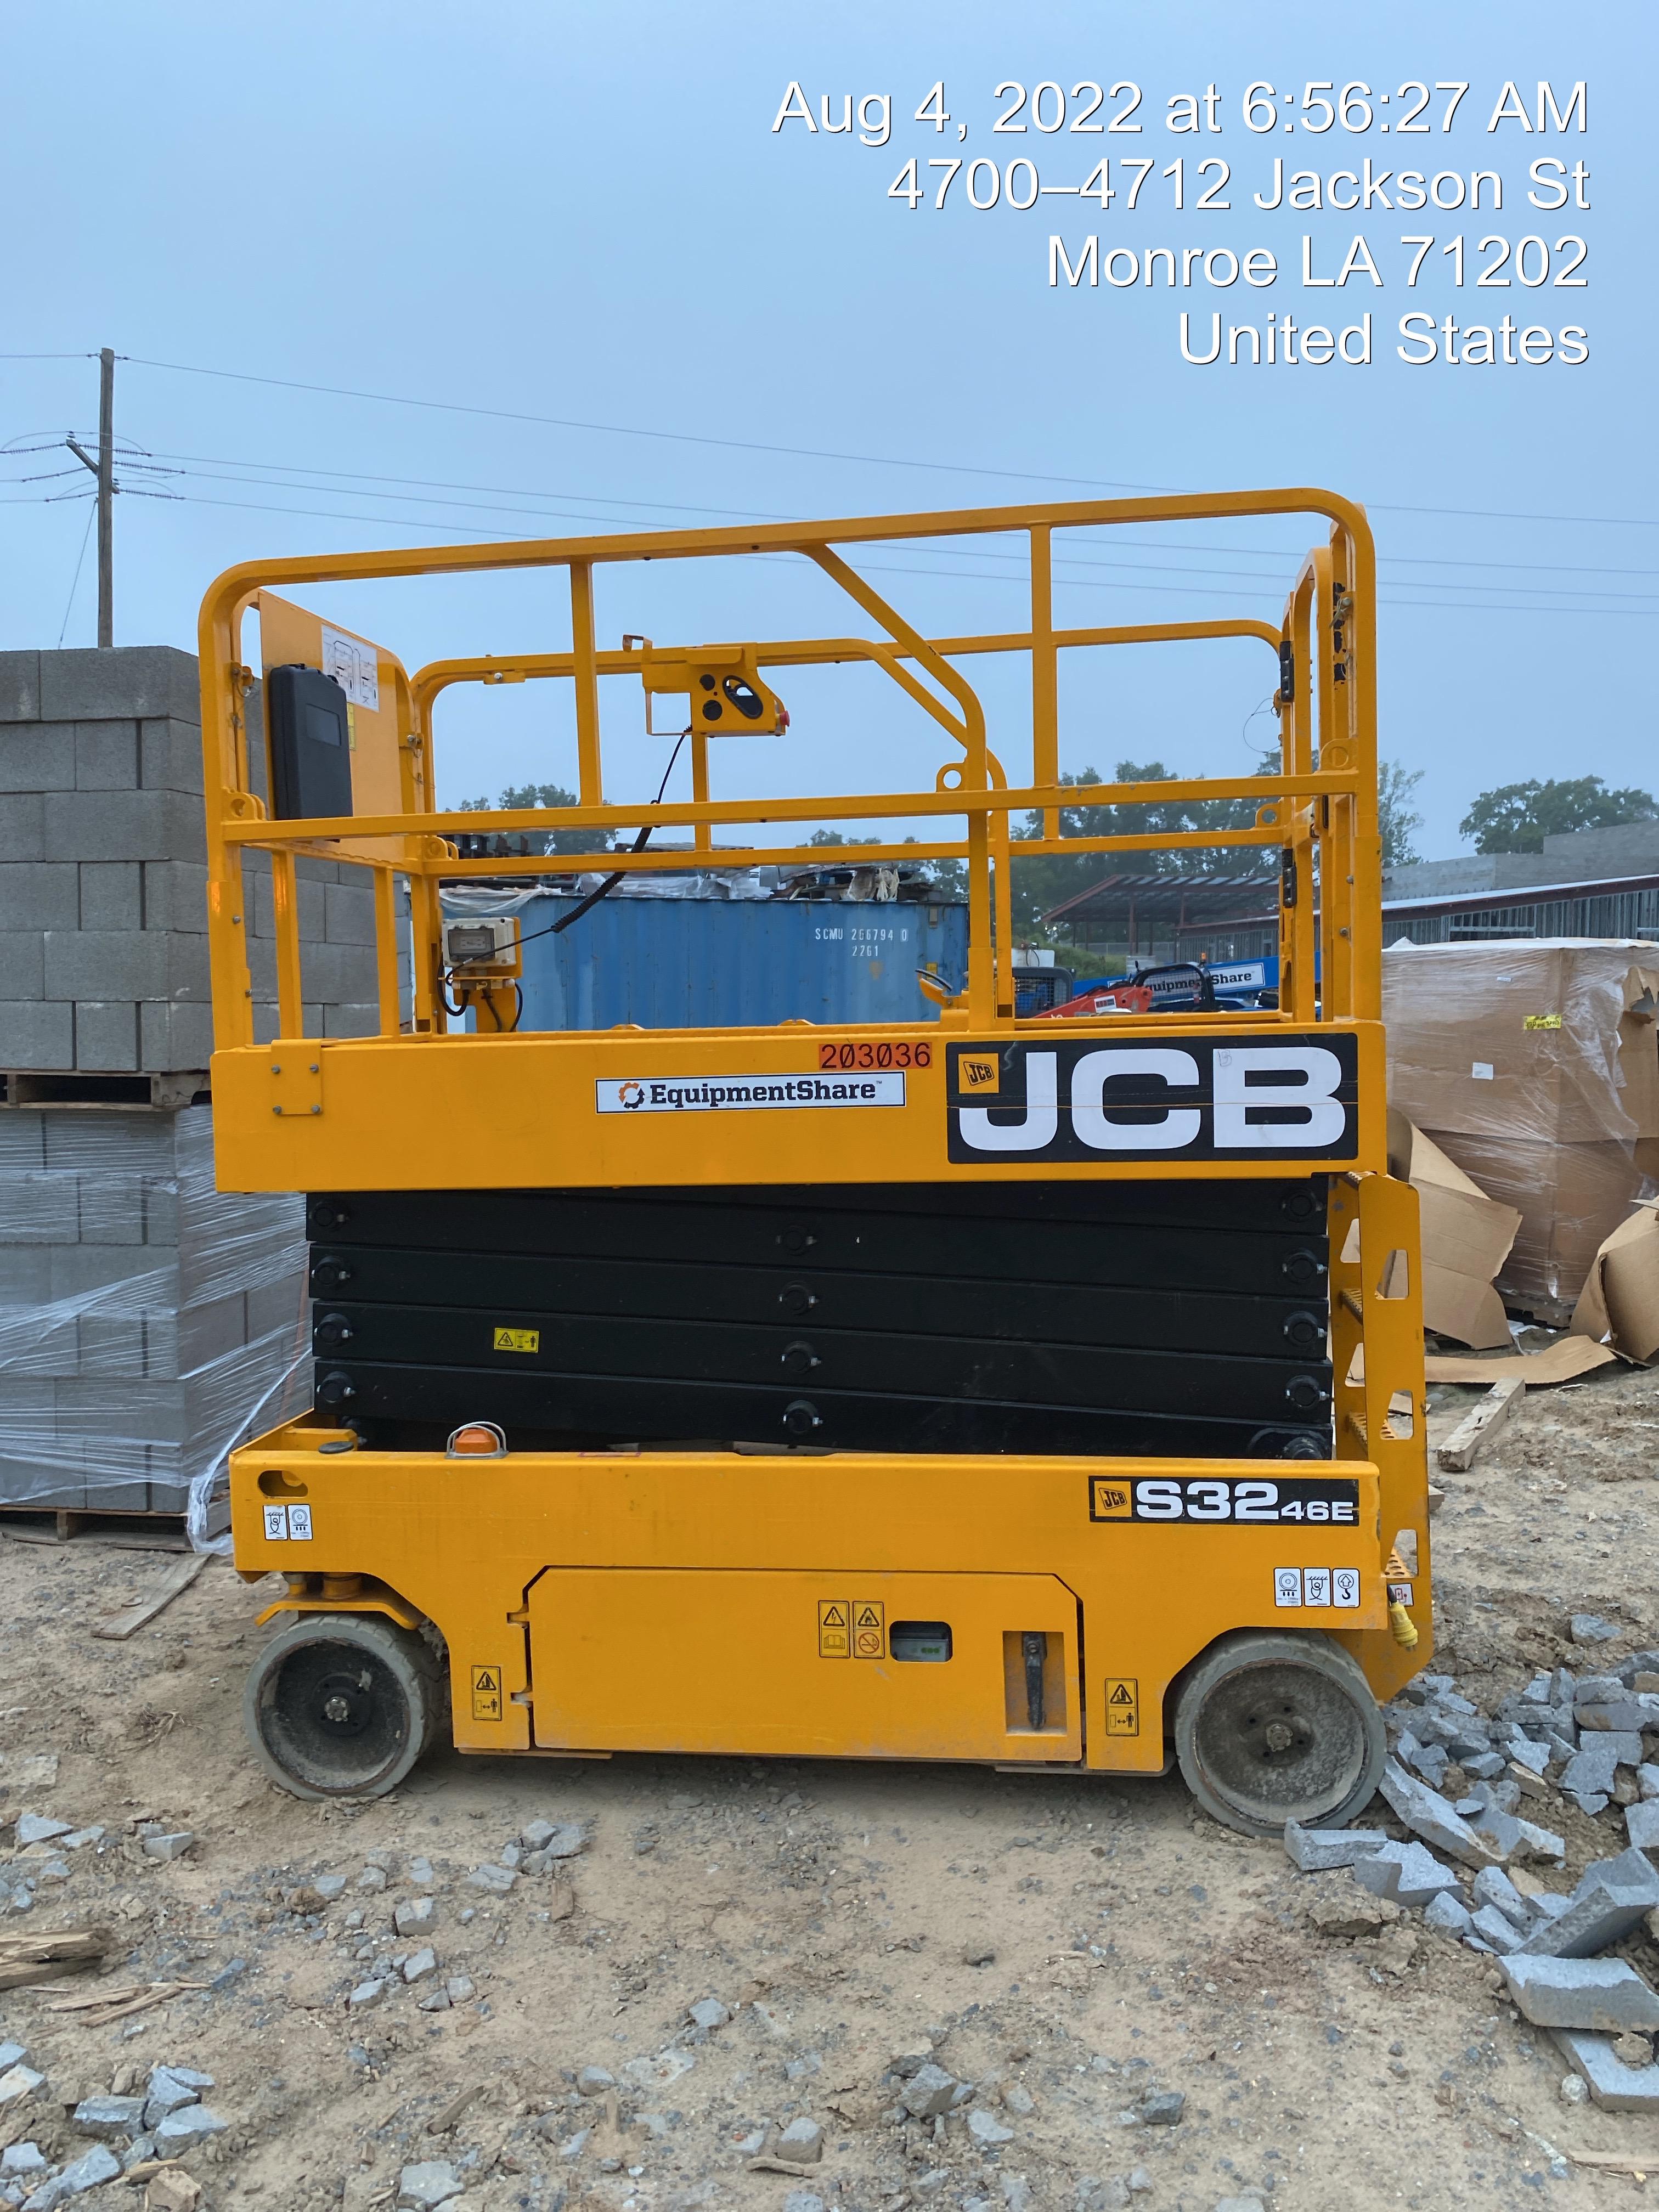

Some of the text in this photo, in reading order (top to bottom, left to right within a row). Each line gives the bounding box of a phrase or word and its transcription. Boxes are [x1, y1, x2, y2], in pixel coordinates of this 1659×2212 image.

[820, 1042, 932, 1069] 203036
[968, 1064, 994, 1084] JCB
[959, 1046, 1346, 1151] JCB
[1103, 1490, 1126, 1509] JCB
